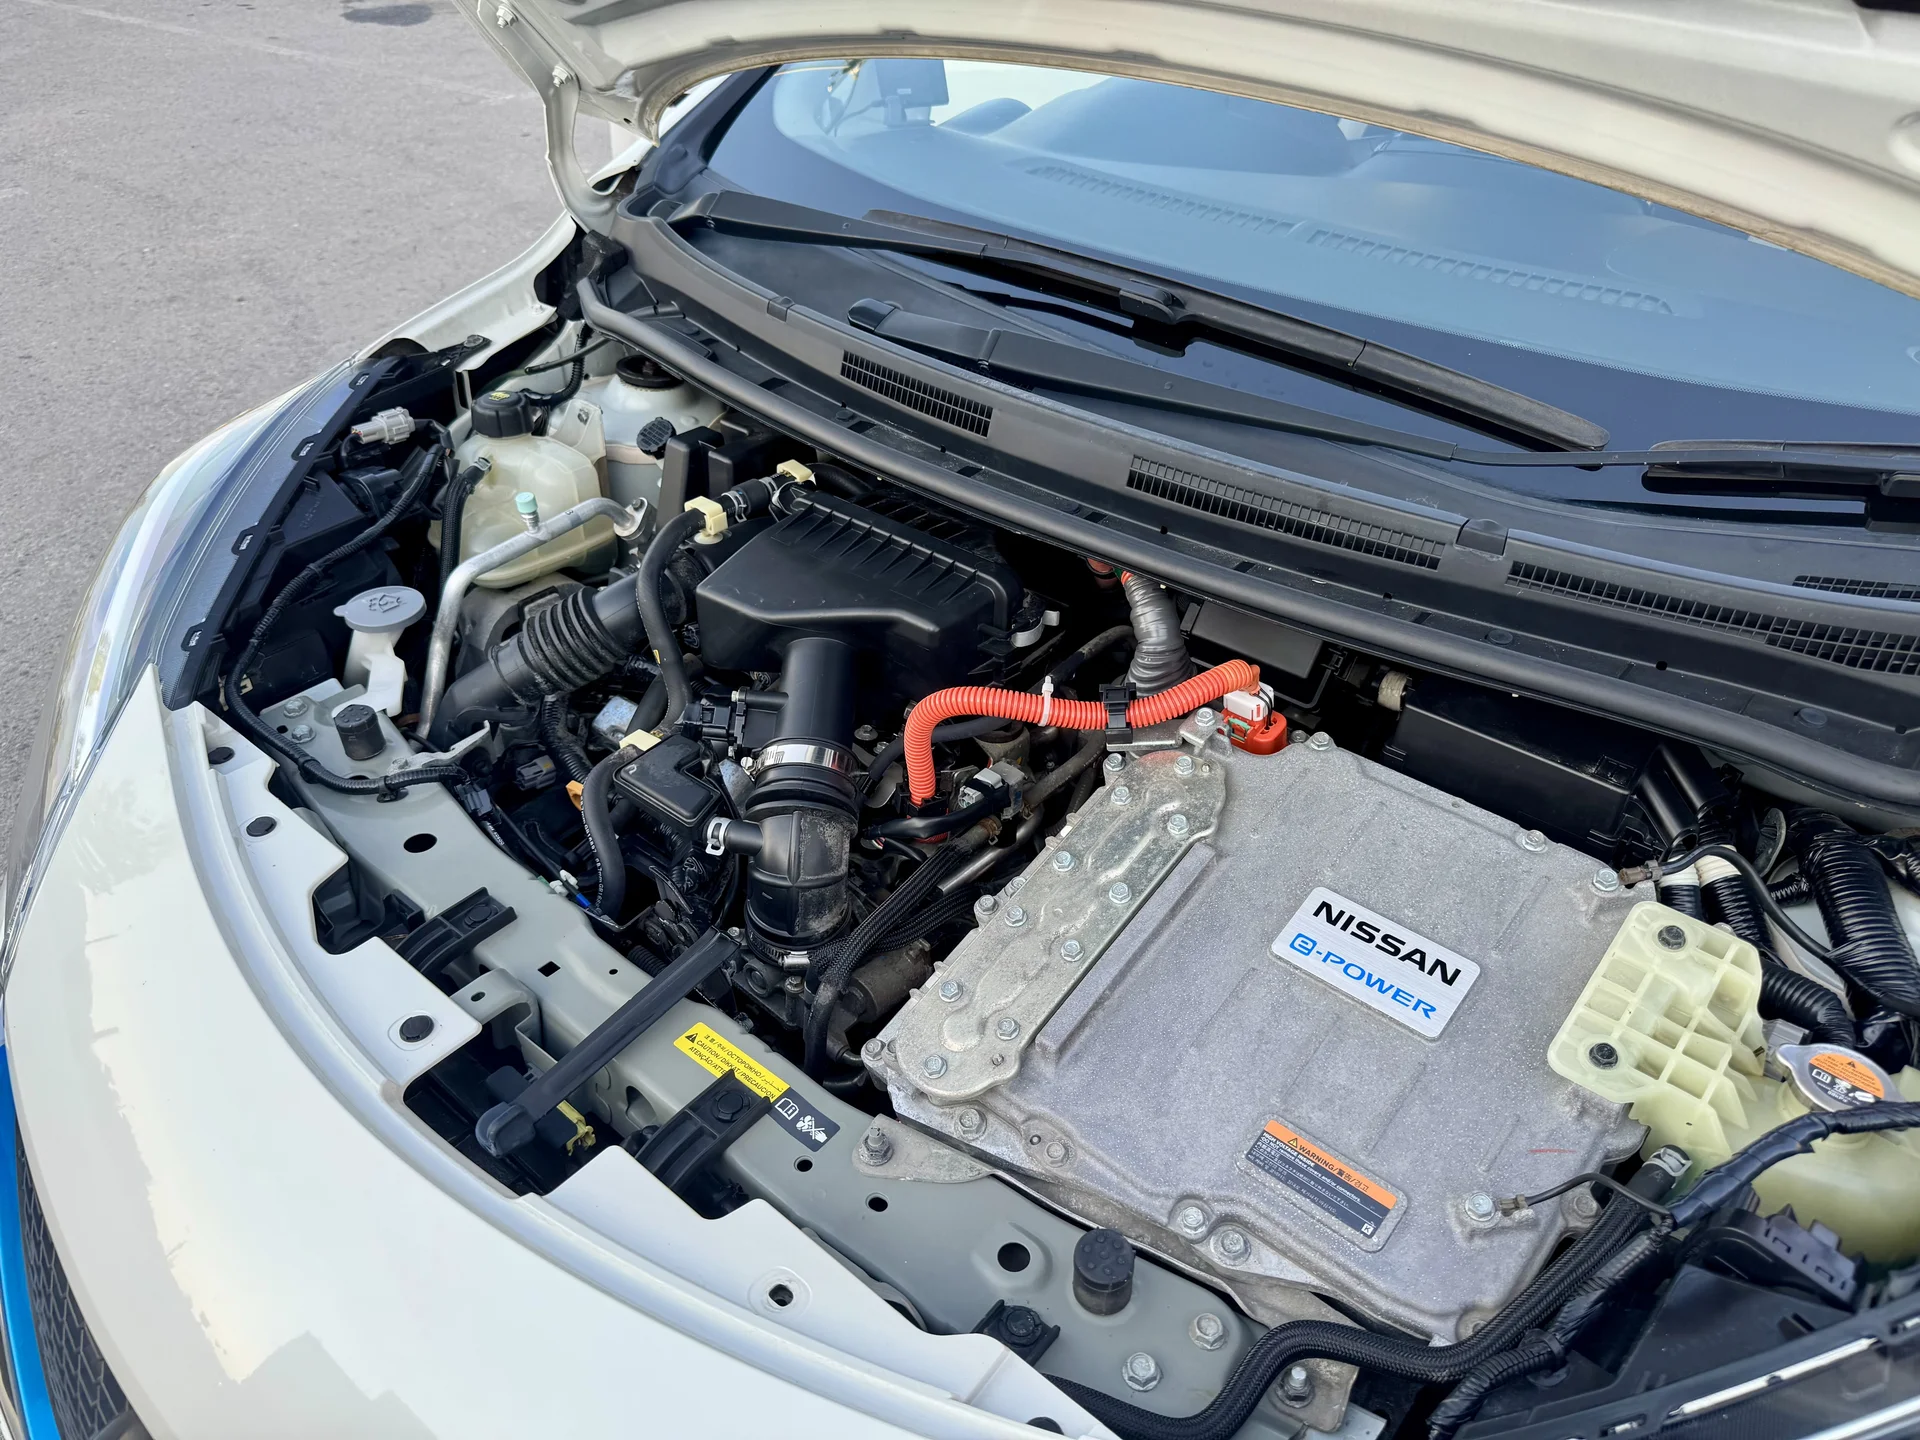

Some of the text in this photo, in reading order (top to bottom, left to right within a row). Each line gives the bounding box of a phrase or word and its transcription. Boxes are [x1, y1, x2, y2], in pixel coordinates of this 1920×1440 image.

[1312, 900, 1462, 987] NISSAN
[1262, 1131, 1315, 1167] HIGH VOLTAGE INSIDE
[1278, 1147, 1295, 1160] remove
[1294, 1157, 1308, 1168] these
[1306, 1165, 1322, 1177] covers
